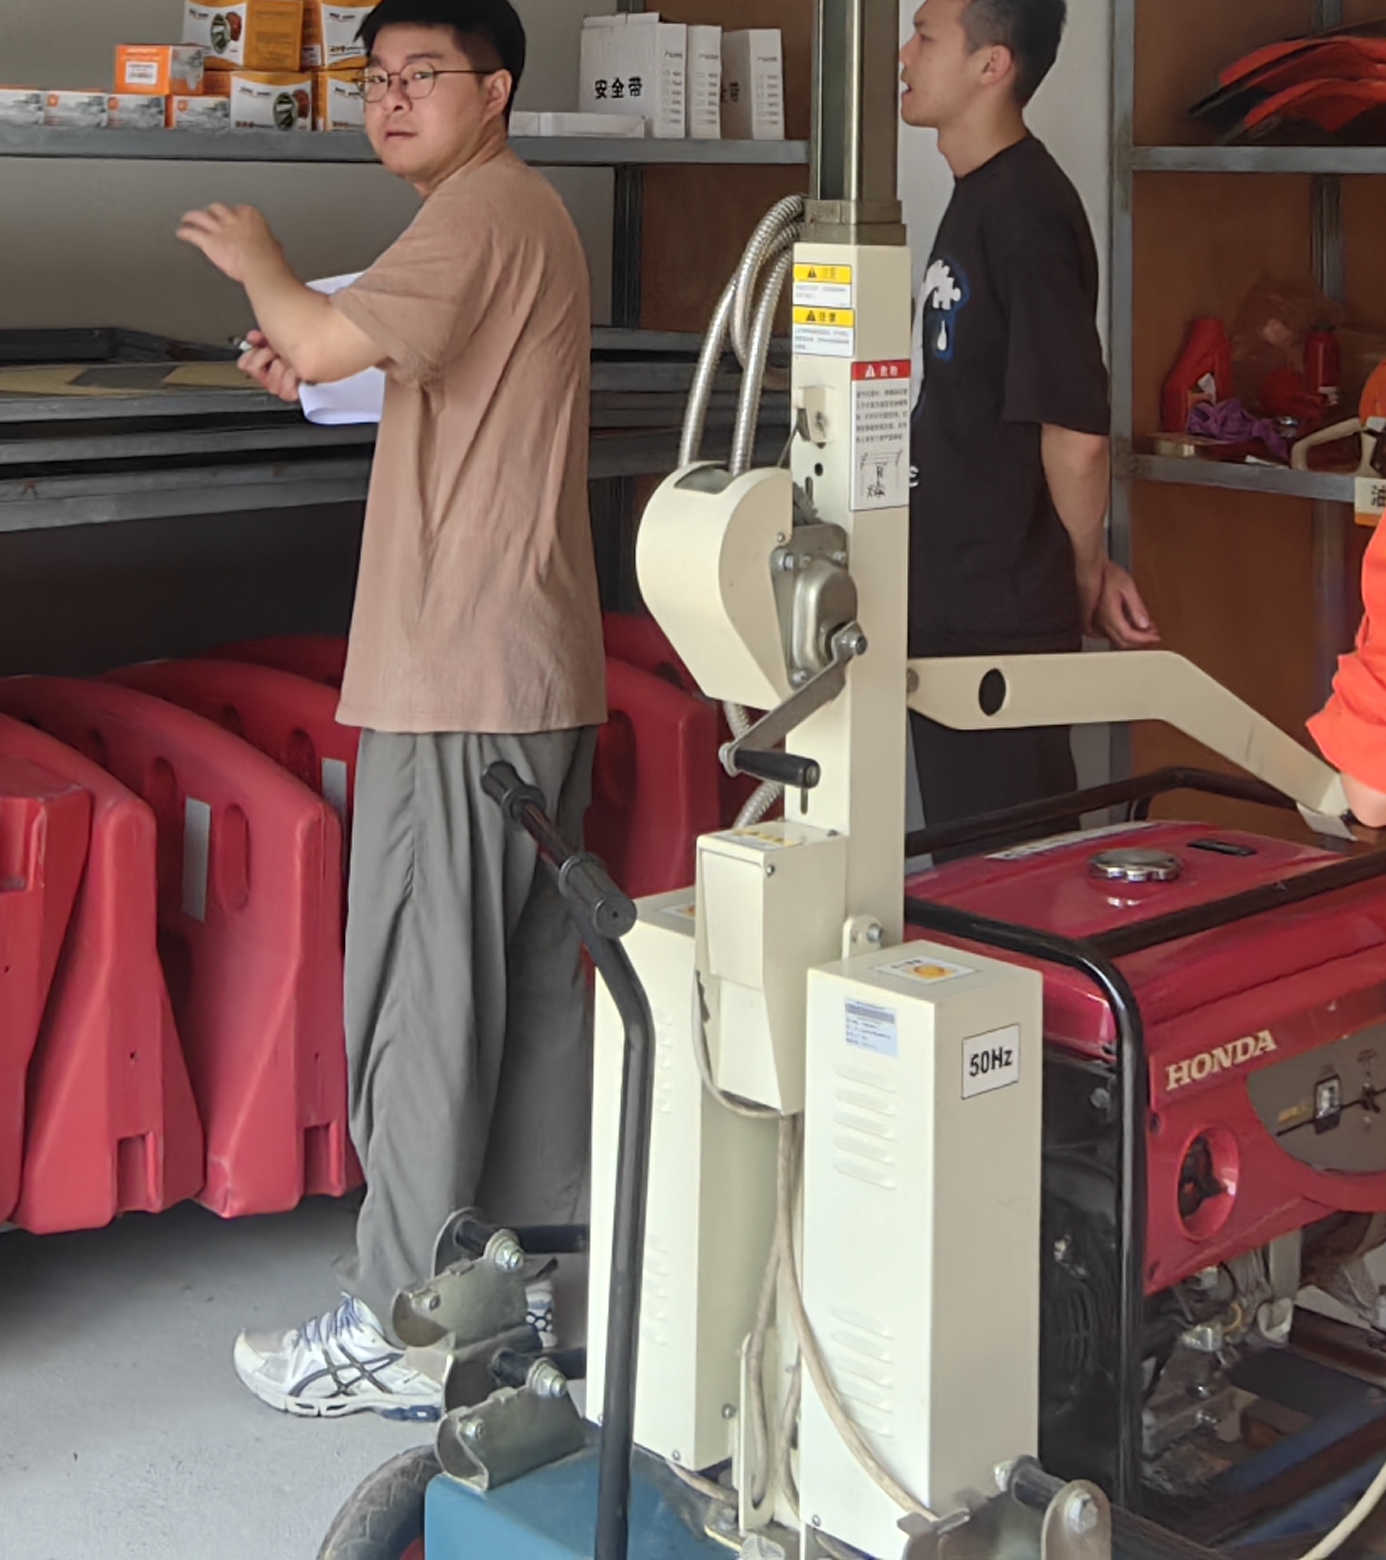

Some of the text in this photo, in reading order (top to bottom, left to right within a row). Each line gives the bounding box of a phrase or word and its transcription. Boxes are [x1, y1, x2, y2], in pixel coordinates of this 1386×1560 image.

[594, 76, 643, 101] 安全带
[968, 1046, 1014, 1078] 50Hz
[1164, 1029, 1278, 1092] HONDA
